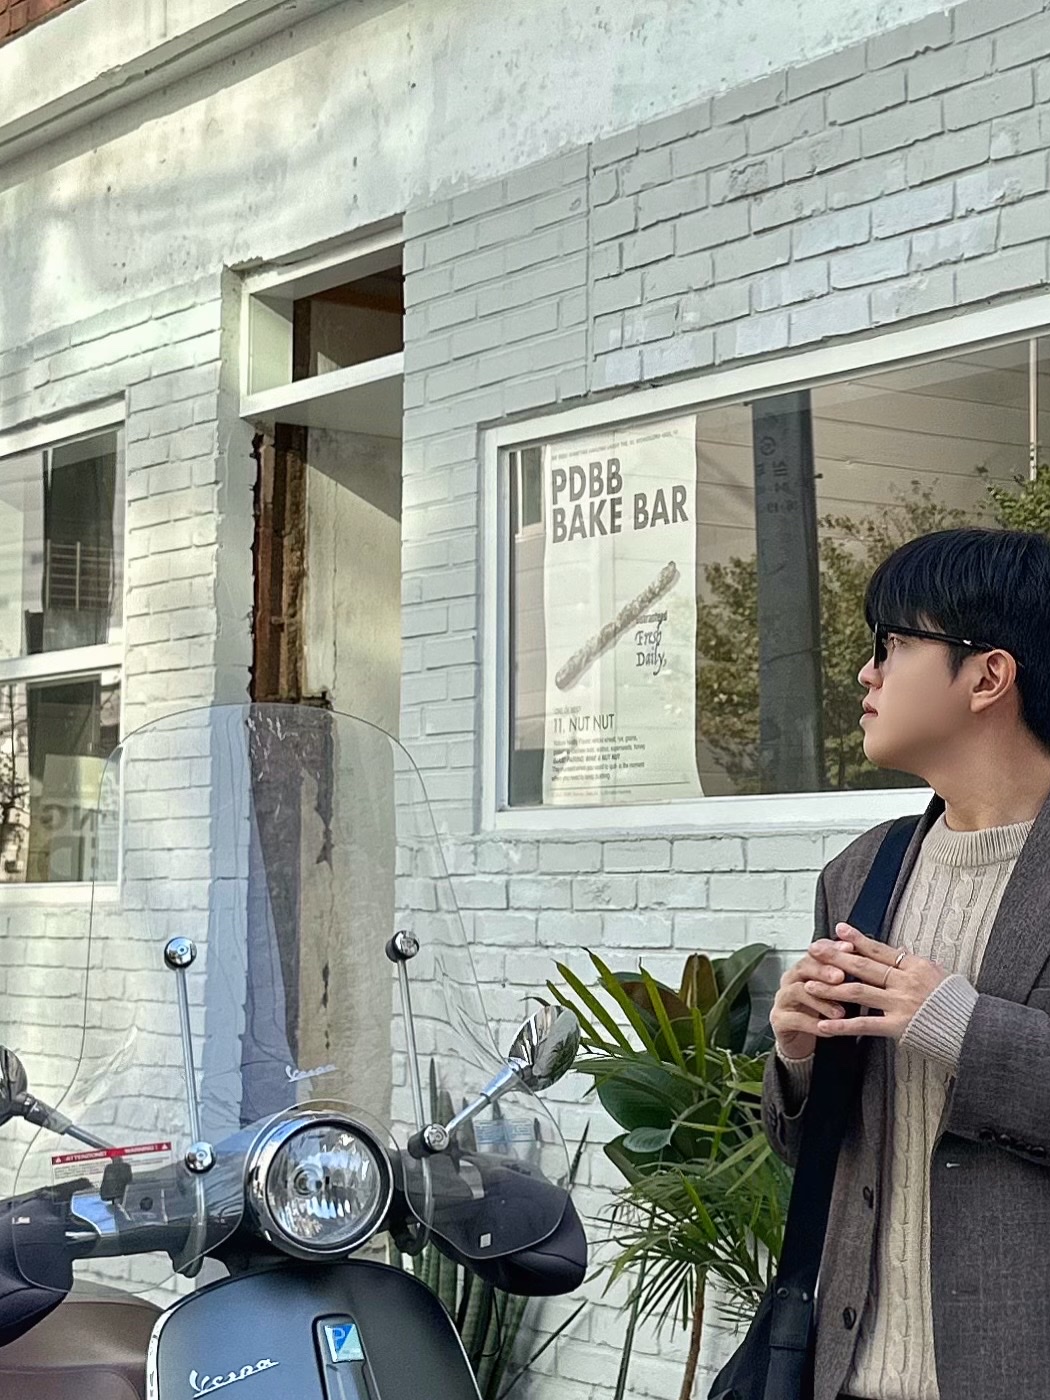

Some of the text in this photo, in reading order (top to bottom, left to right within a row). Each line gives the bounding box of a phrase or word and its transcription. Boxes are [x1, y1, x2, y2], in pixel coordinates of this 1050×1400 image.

[551, 458, 623, 505] PDBB
[552, 485, 689, 544] BAKE BAR
[569, 715, 591, 733] NUT
[593, 713, 615, 732] NUT
[189, 1357, 280, 1400] Vespa
